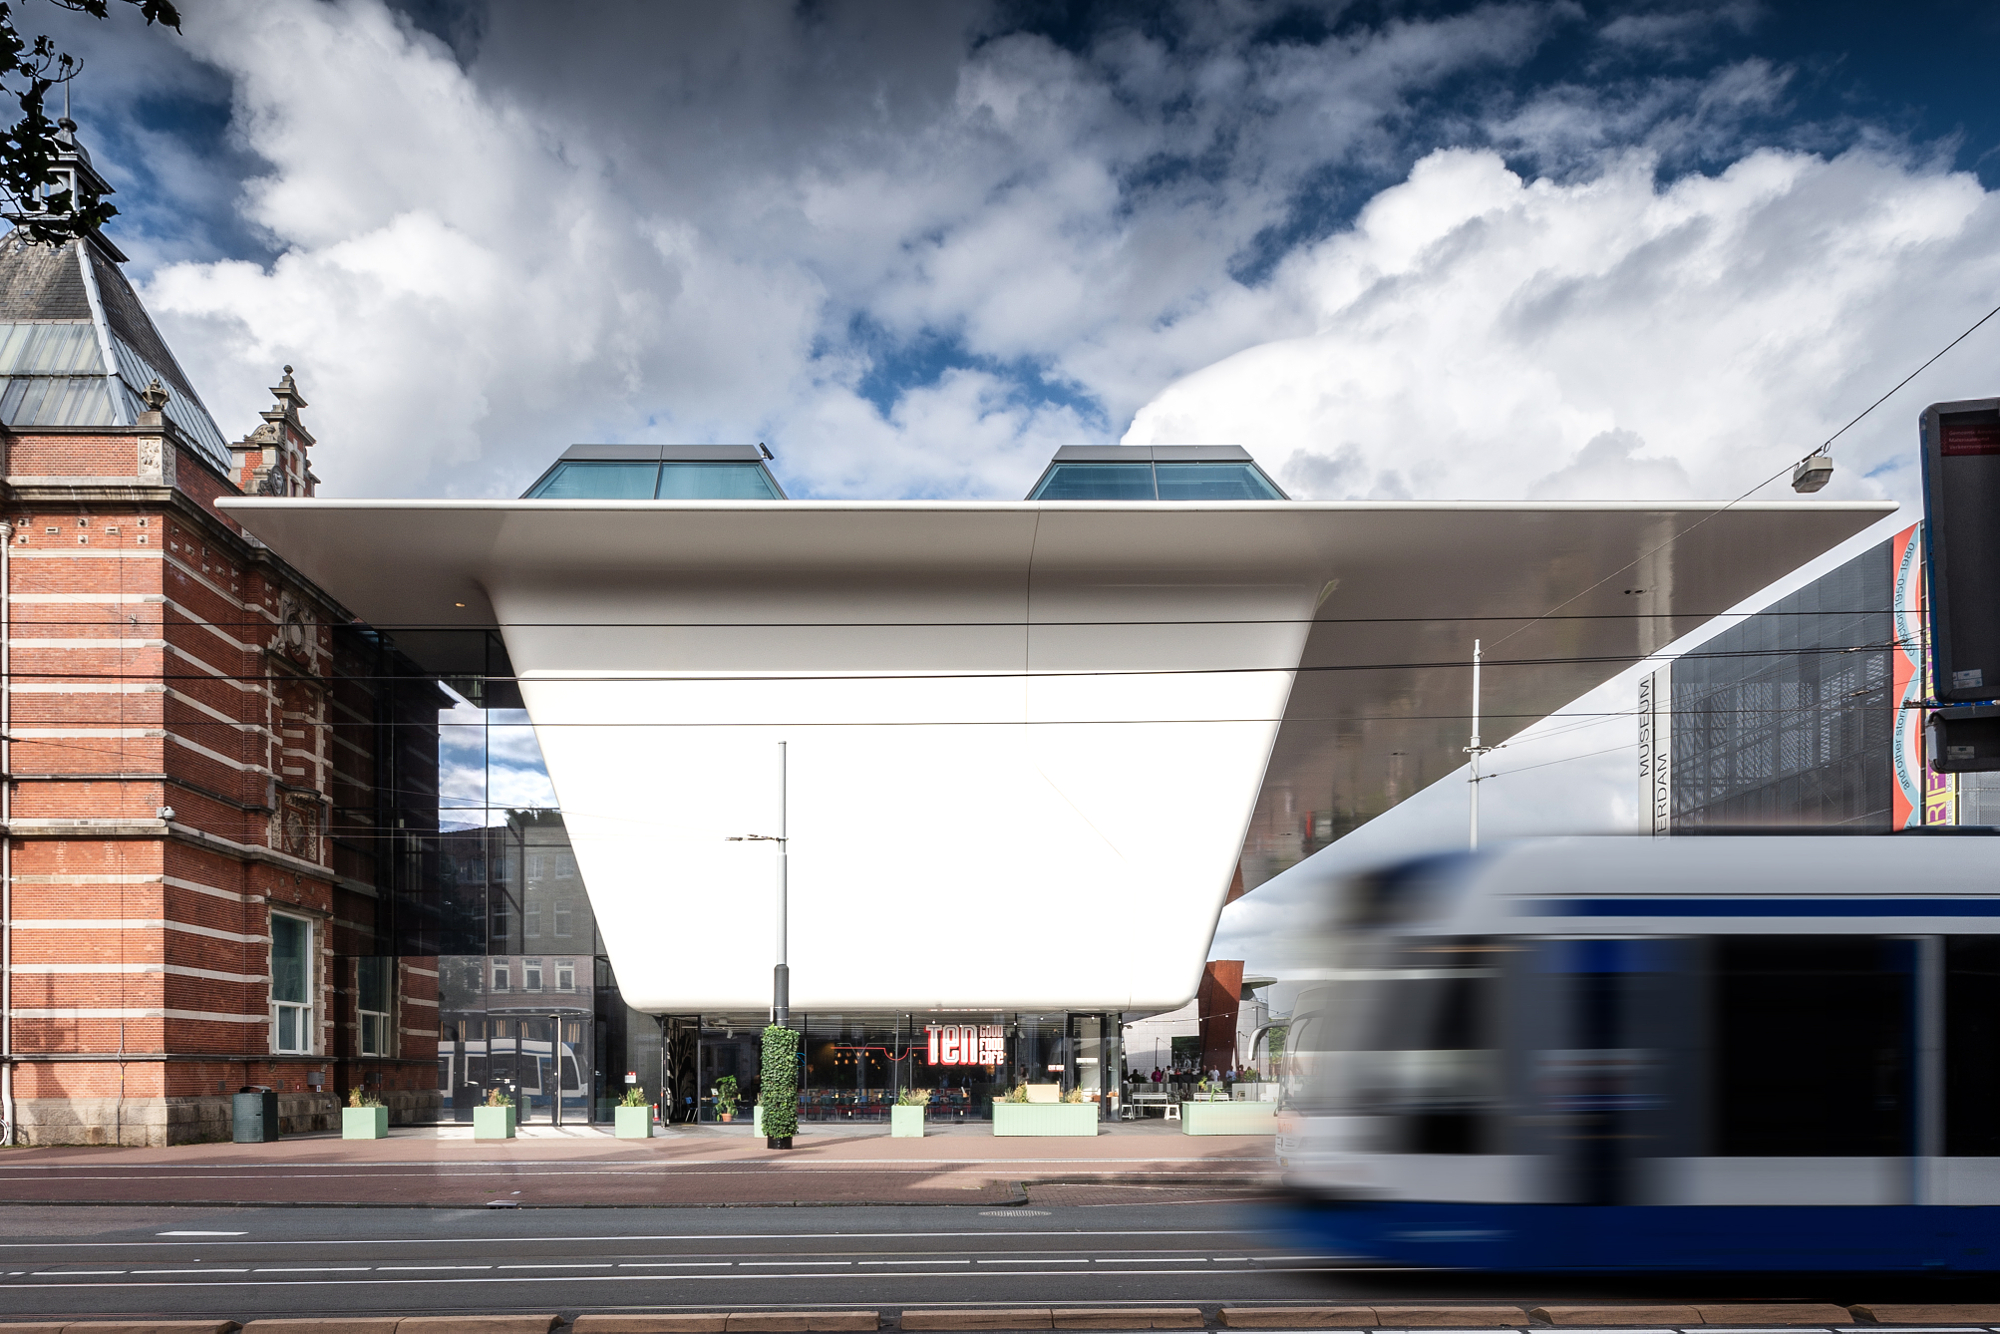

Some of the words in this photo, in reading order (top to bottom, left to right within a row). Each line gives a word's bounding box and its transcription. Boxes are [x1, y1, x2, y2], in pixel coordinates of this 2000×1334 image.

[1895, 542, 1915, 607] 1950-1980
[1640, 680, 1650, 777] MUSEUM
[1895, 696, 1910, 736] storis
[1894, 738, 1903, 769] other
[1657, 753, 1667, 836] ERDAM
[1897, 769, 1910, 790] and
[979, 1024, 1004, 1037] GOOD
[979, 1037, 1004, 1051] FOOD
